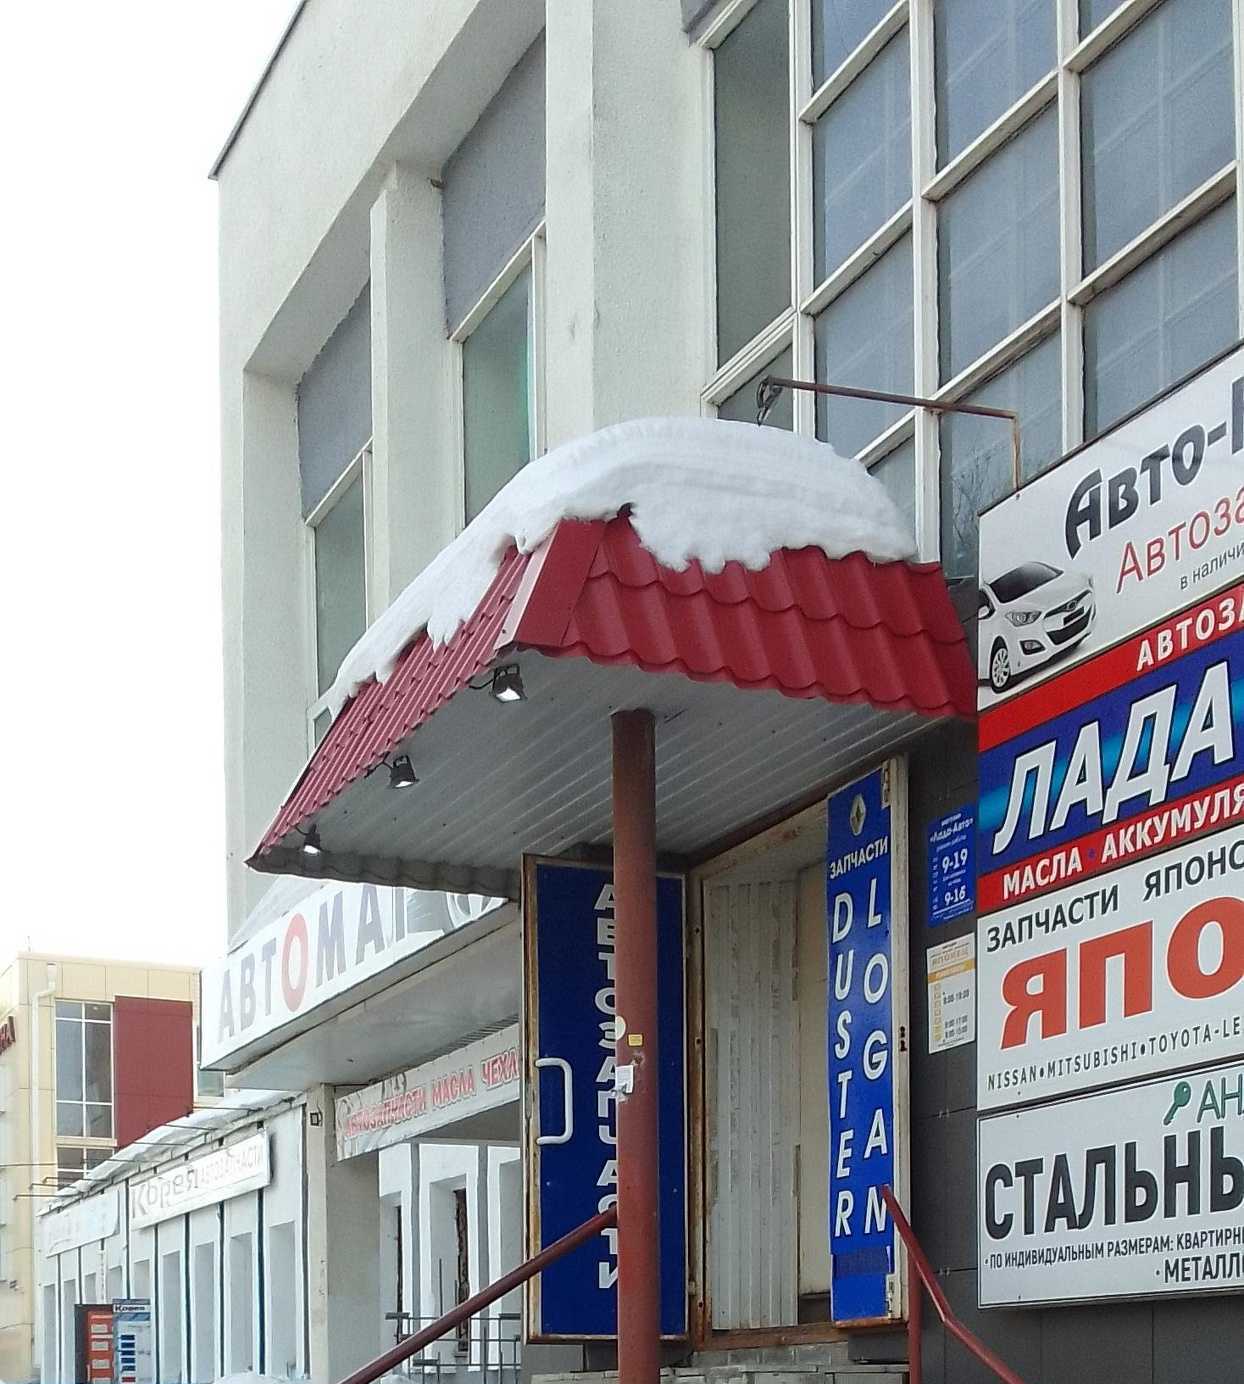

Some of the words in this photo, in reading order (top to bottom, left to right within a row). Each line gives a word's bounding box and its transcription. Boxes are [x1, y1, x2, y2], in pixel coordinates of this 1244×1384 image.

[1180, 575, 1189, 591] в
[1136, 597, 1244, 672] АВТОЗ
[992, 660, 1234, 856] ЛАДА
[830, 835, 888, 880] ЗАПЧАСТИ
[942, 847, 968, 874] 9-19
[1003, 847, 1083, 900] МАСЛА
[1101, 783, 1244, 864] АККУМУЛЯ
[986, 883, 1119, 953] ЗАПЧАСТИ
[1000, 896, 1244, 1050] ЯПО
[832, 892, 855, 1238] DUSTER
[863, 877, 890, 1234] LOGAN
[988, 1066, 1038, 1092] NISSAN
[1047, 1041, 1137, 1079] MITSUBISHI
[1197, 1073, 1244, 1123] АН
[990, 1253, 1002, 1269] ПО
[1005, 1242, 1104, 1269] ИНДИВИДУАЛЬНЫМ
[1108, 1234, 1174, 1258] РАЗМЕРАМ:
[1177, 1226, 1244, 1250] КВАРТИРН
[1165, 1252, 1244, 1284] МЕТАЛЛ
